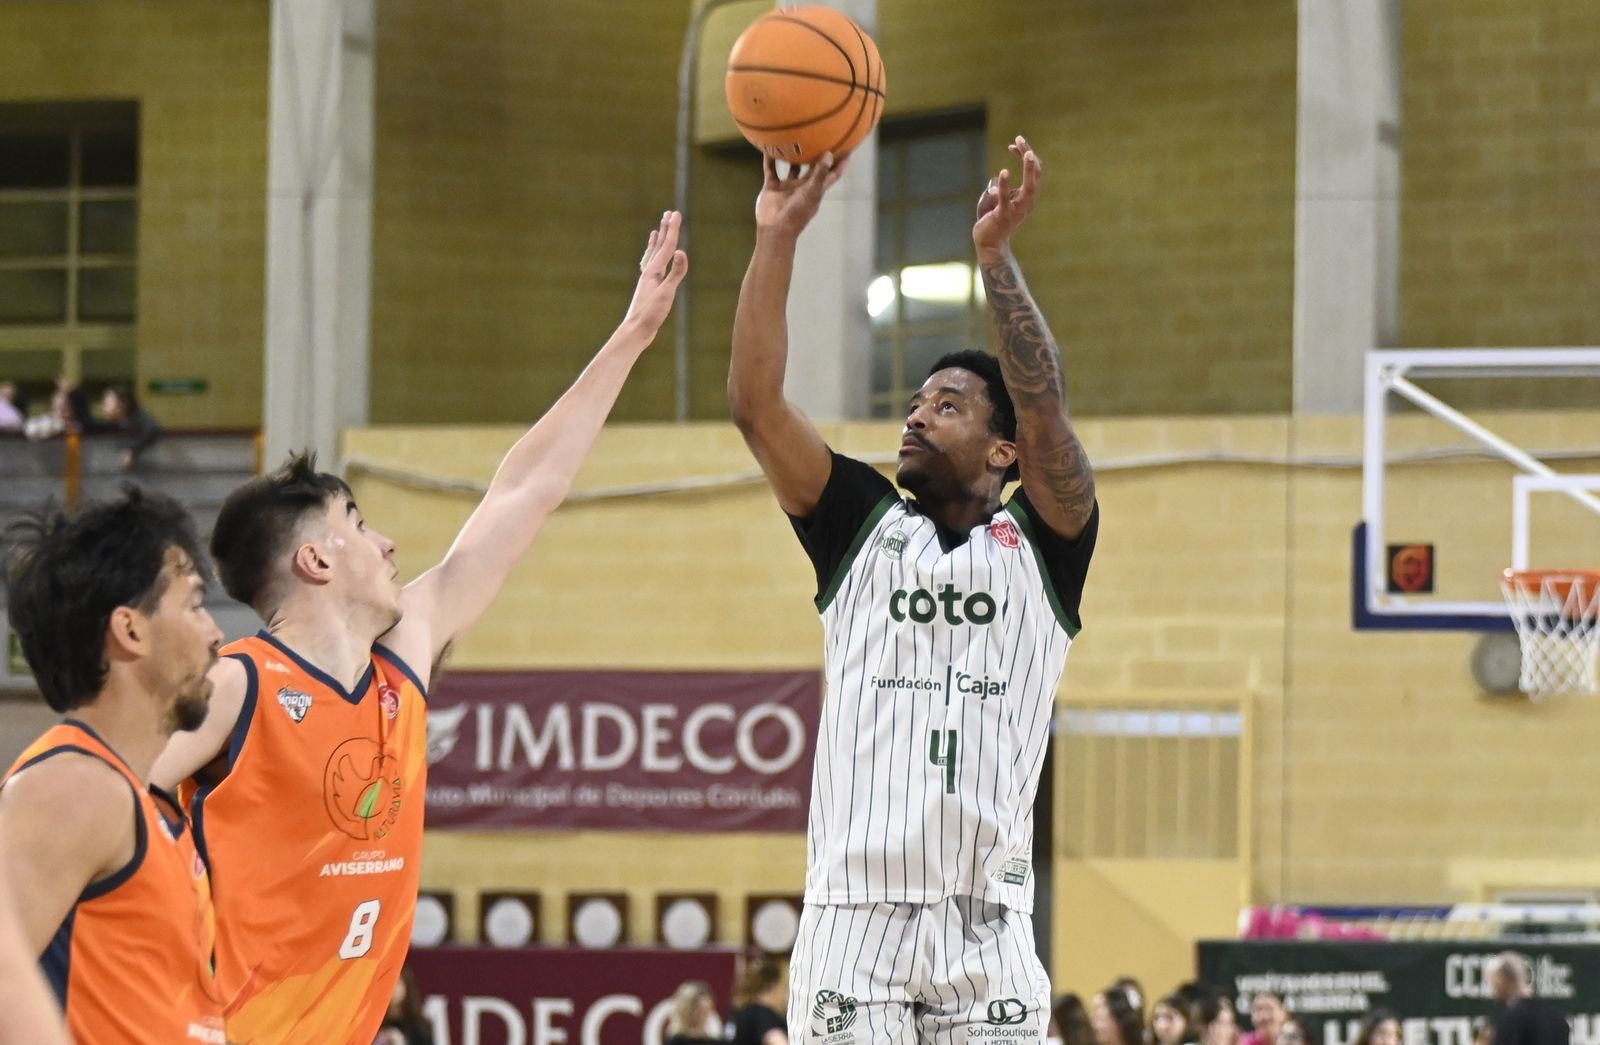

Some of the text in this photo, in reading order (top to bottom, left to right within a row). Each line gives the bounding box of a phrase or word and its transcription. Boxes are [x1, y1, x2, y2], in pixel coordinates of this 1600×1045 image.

[889, 583, 997, 626] coto
[871, 671, 1007, 701] Fundación Cajas
[475, 702, 807, 774] IMDECO
[928, 729, 958, 795] 4
[319, 857, 404, 877] AVISERRANO
[352, 850, 385, 861] GRUPO
[337, 898, 383, 961] 8
[424, 994, 674, 1045] DEC
[967, 1026, 1039, 1040] SohoBoutique
